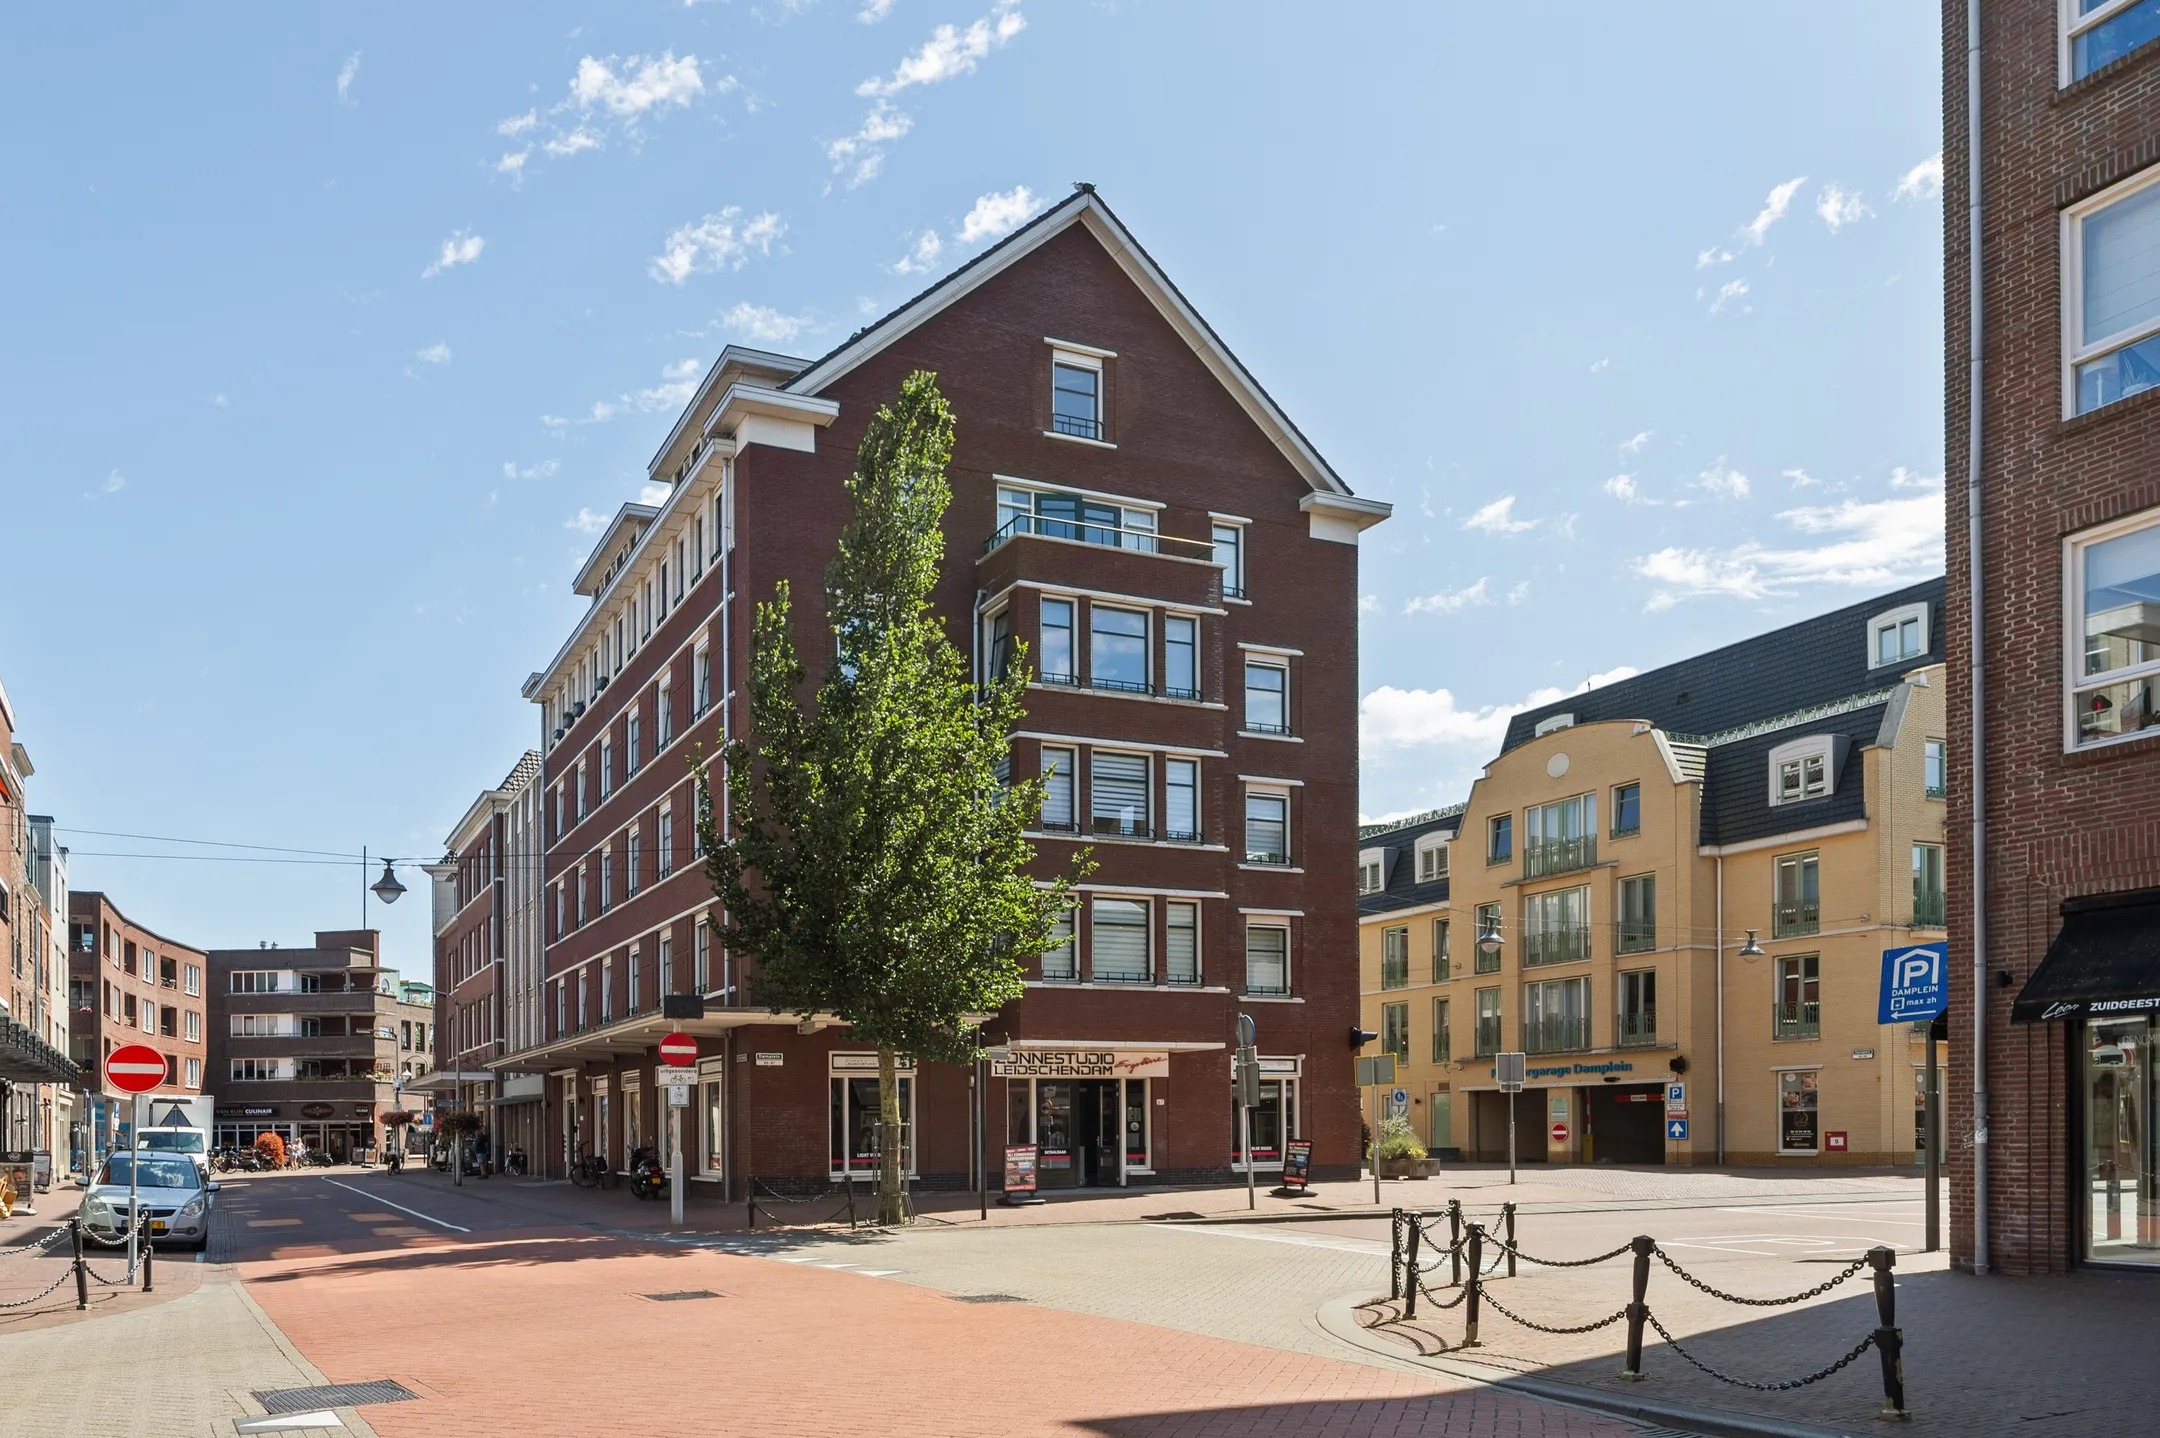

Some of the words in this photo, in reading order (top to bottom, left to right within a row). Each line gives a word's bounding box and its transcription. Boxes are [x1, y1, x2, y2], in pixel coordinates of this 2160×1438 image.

[1892, 985, 1938, 997] DAMPLEIN
[2089, 998, 2160, 1011] ZUIDGEEST
[994, 1065, 1113, 1076] LEIDSCHENDAM
[1114, 1056, 1168, 1074] Ergoline
[1491, 1066, 1571, 1079] Prgarage
[1573, 1061, 1633, 1075] Damplein
[660, 1068, 698, 1076] uitgezonderd
[1672, 1087, 1680, 1099] P
